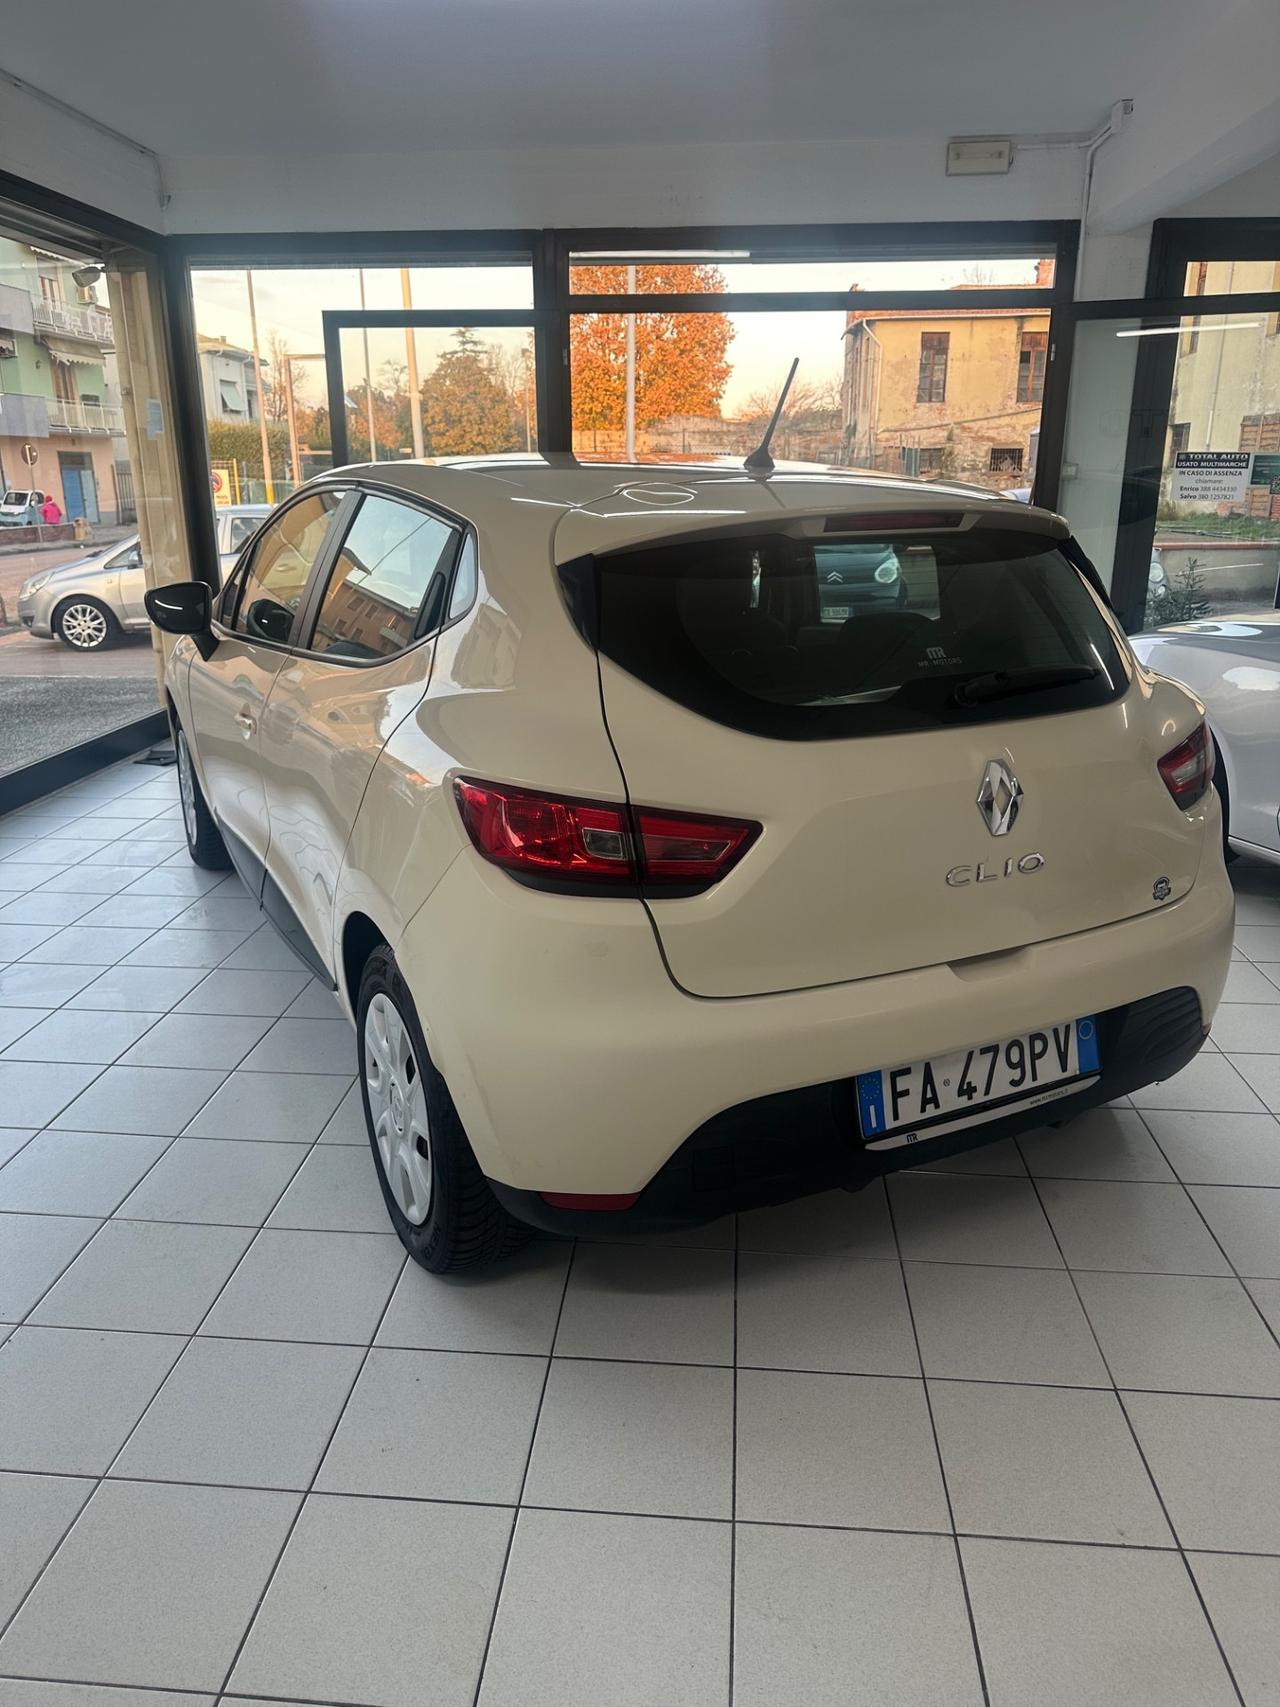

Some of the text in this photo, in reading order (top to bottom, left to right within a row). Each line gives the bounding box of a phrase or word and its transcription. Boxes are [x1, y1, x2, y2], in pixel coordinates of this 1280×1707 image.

[945, 852, 1046, 888] CLIO
[889, 1023, 1072, 1122] FA 479PV
